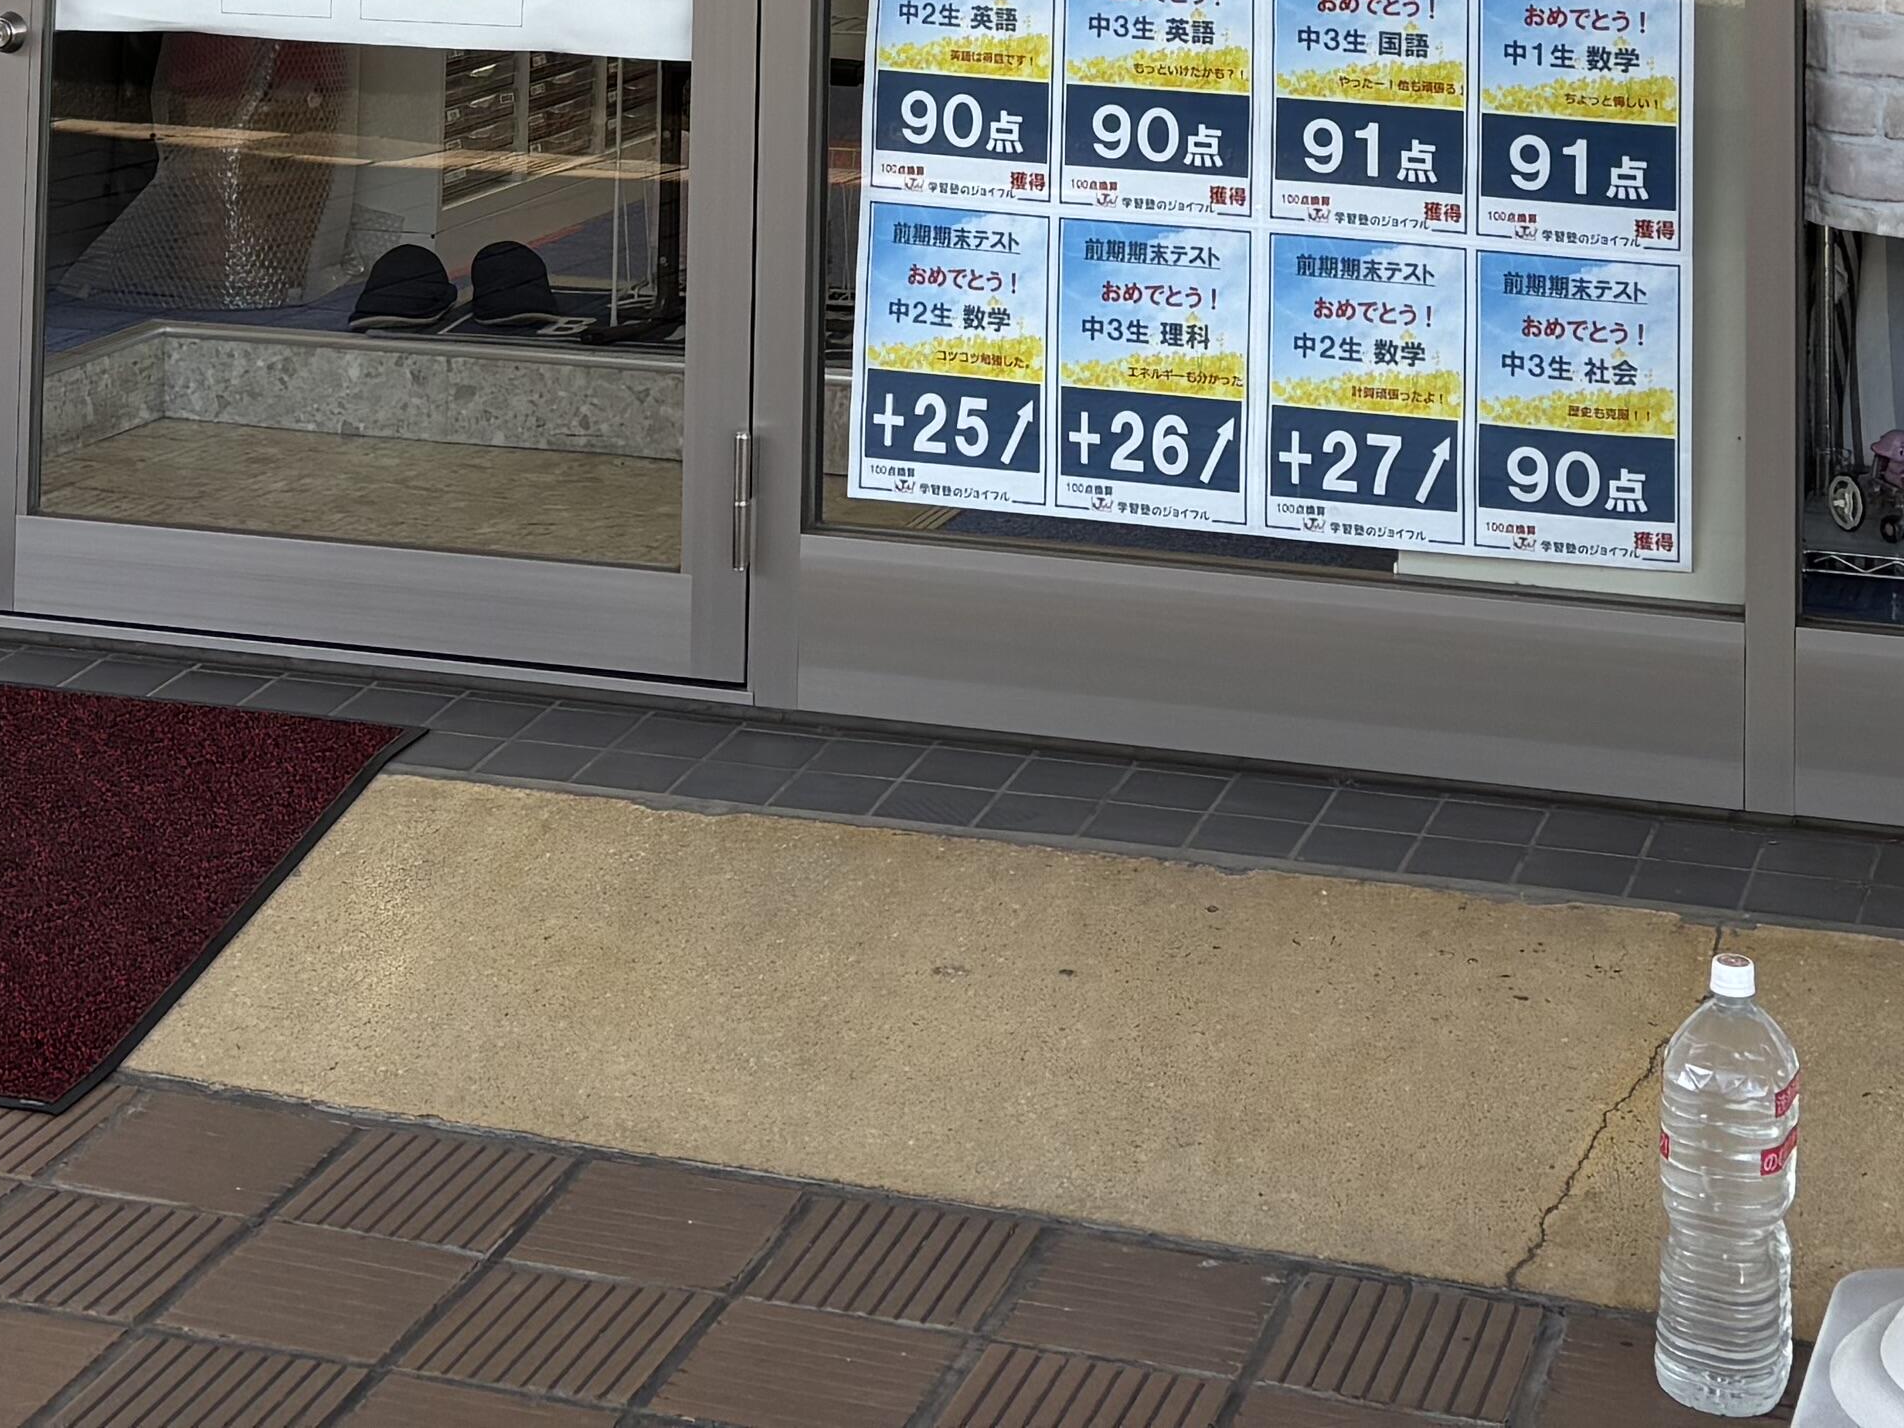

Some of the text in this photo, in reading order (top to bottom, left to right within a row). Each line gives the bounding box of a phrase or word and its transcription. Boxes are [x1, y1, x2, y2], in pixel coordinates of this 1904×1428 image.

[901, 90, 1024, 154] 90点
[1092, 104, 1223, 168] 90点
[1302, 119, 1438, 184] 91点
[1509, 134, 1649, 201] 91点
[873, 392, 989, 457] +25
[1069, 410, 1188, 475] +26
[1278, 430, 1402, 495] +27
[1506, 445, 1648, 514] 90点
